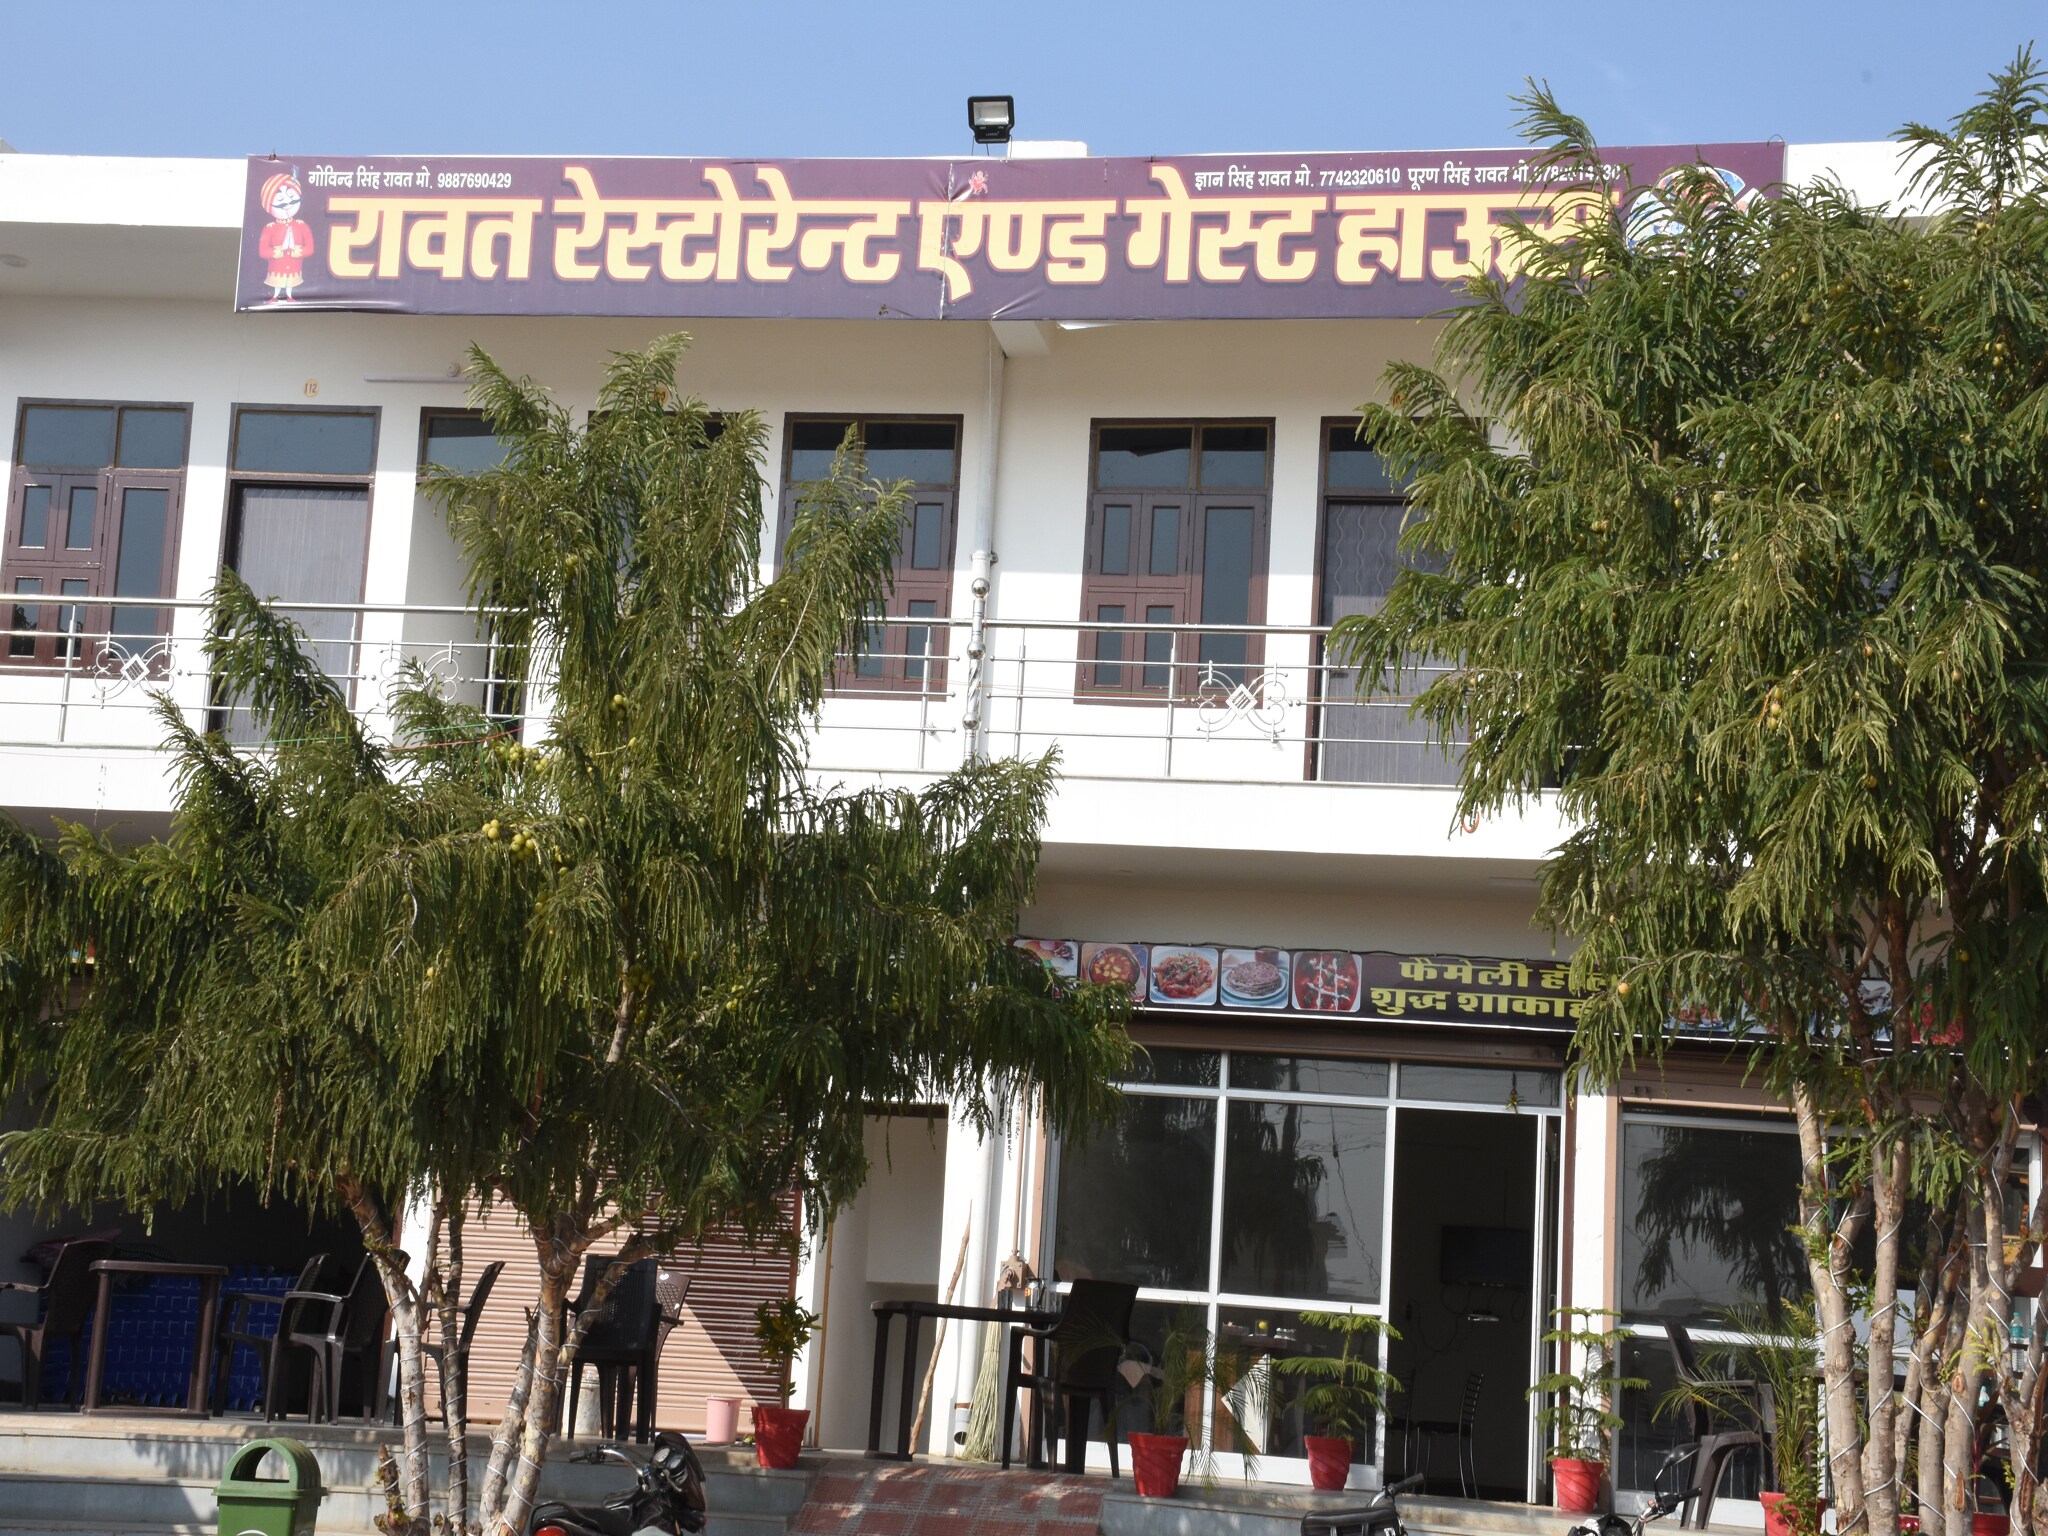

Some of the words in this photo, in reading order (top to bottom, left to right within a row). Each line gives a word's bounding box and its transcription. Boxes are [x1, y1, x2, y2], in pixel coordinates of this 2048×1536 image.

[308, 165, 354, 188] गोविन्द
[356, 165, 381, 189] सिंह
[383, 171, 413, 188] रावत
[415, 166, 433, 189] मो.
[437, 172, 511, 188] 9887690429
[1195, 171, 1224, 190] ज्ञान
[1228, 165, 1255, 189] सिंह
[1258, 170, 1291, 187] रावत
[1294, 164, 1314, 187] मो.
[1319, 167, 1400, 186] 7742320610
[1407, 167, 1440, 190] पूरण
[1443, 161, 1470, 185] सिंह
[1474, 166, 1509, 183] रावत
[328, 198, 542, 279] रावत
[553, 166, 910, 281] रेस्टोरेन्ट
[918, 199, 1116, 301] एण्ड
[1125, 164, 1327, 283] गेस्ट
[1399, 956, 1533, 988] फैमेली
[1370, 987, 1452, 1016] शुद्ध
[1457, 991, 1602, 1019] शाकाह
